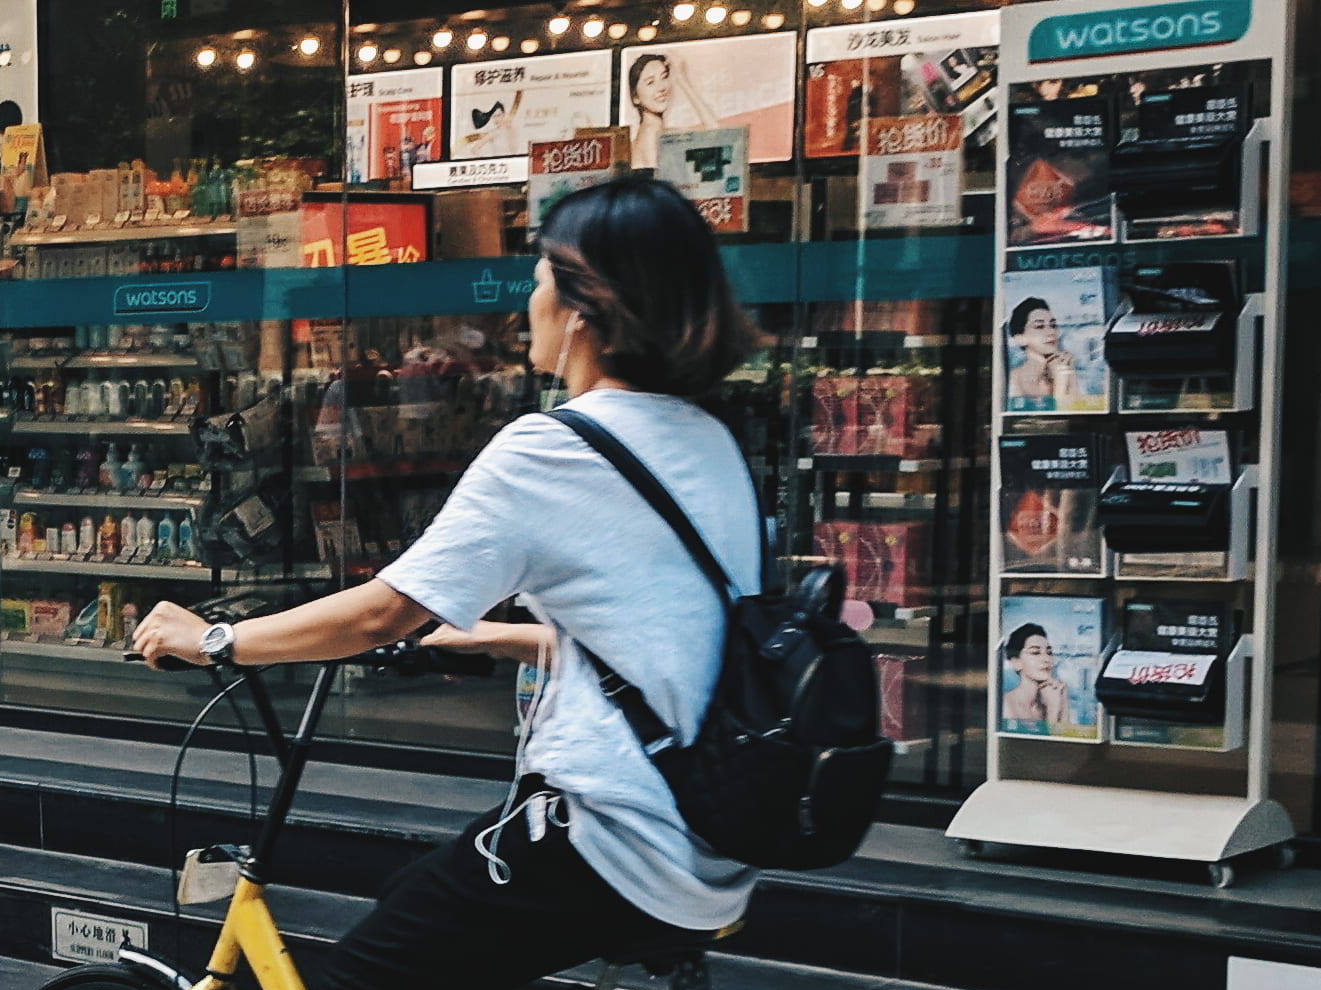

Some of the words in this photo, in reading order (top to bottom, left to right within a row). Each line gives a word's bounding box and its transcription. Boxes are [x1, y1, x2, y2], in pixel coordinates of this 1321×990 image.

[1055, 10, 1223, 50] watsons
[126, 288, 197, 307] watsons
[68, 920, 116, 943] 小心地滑
